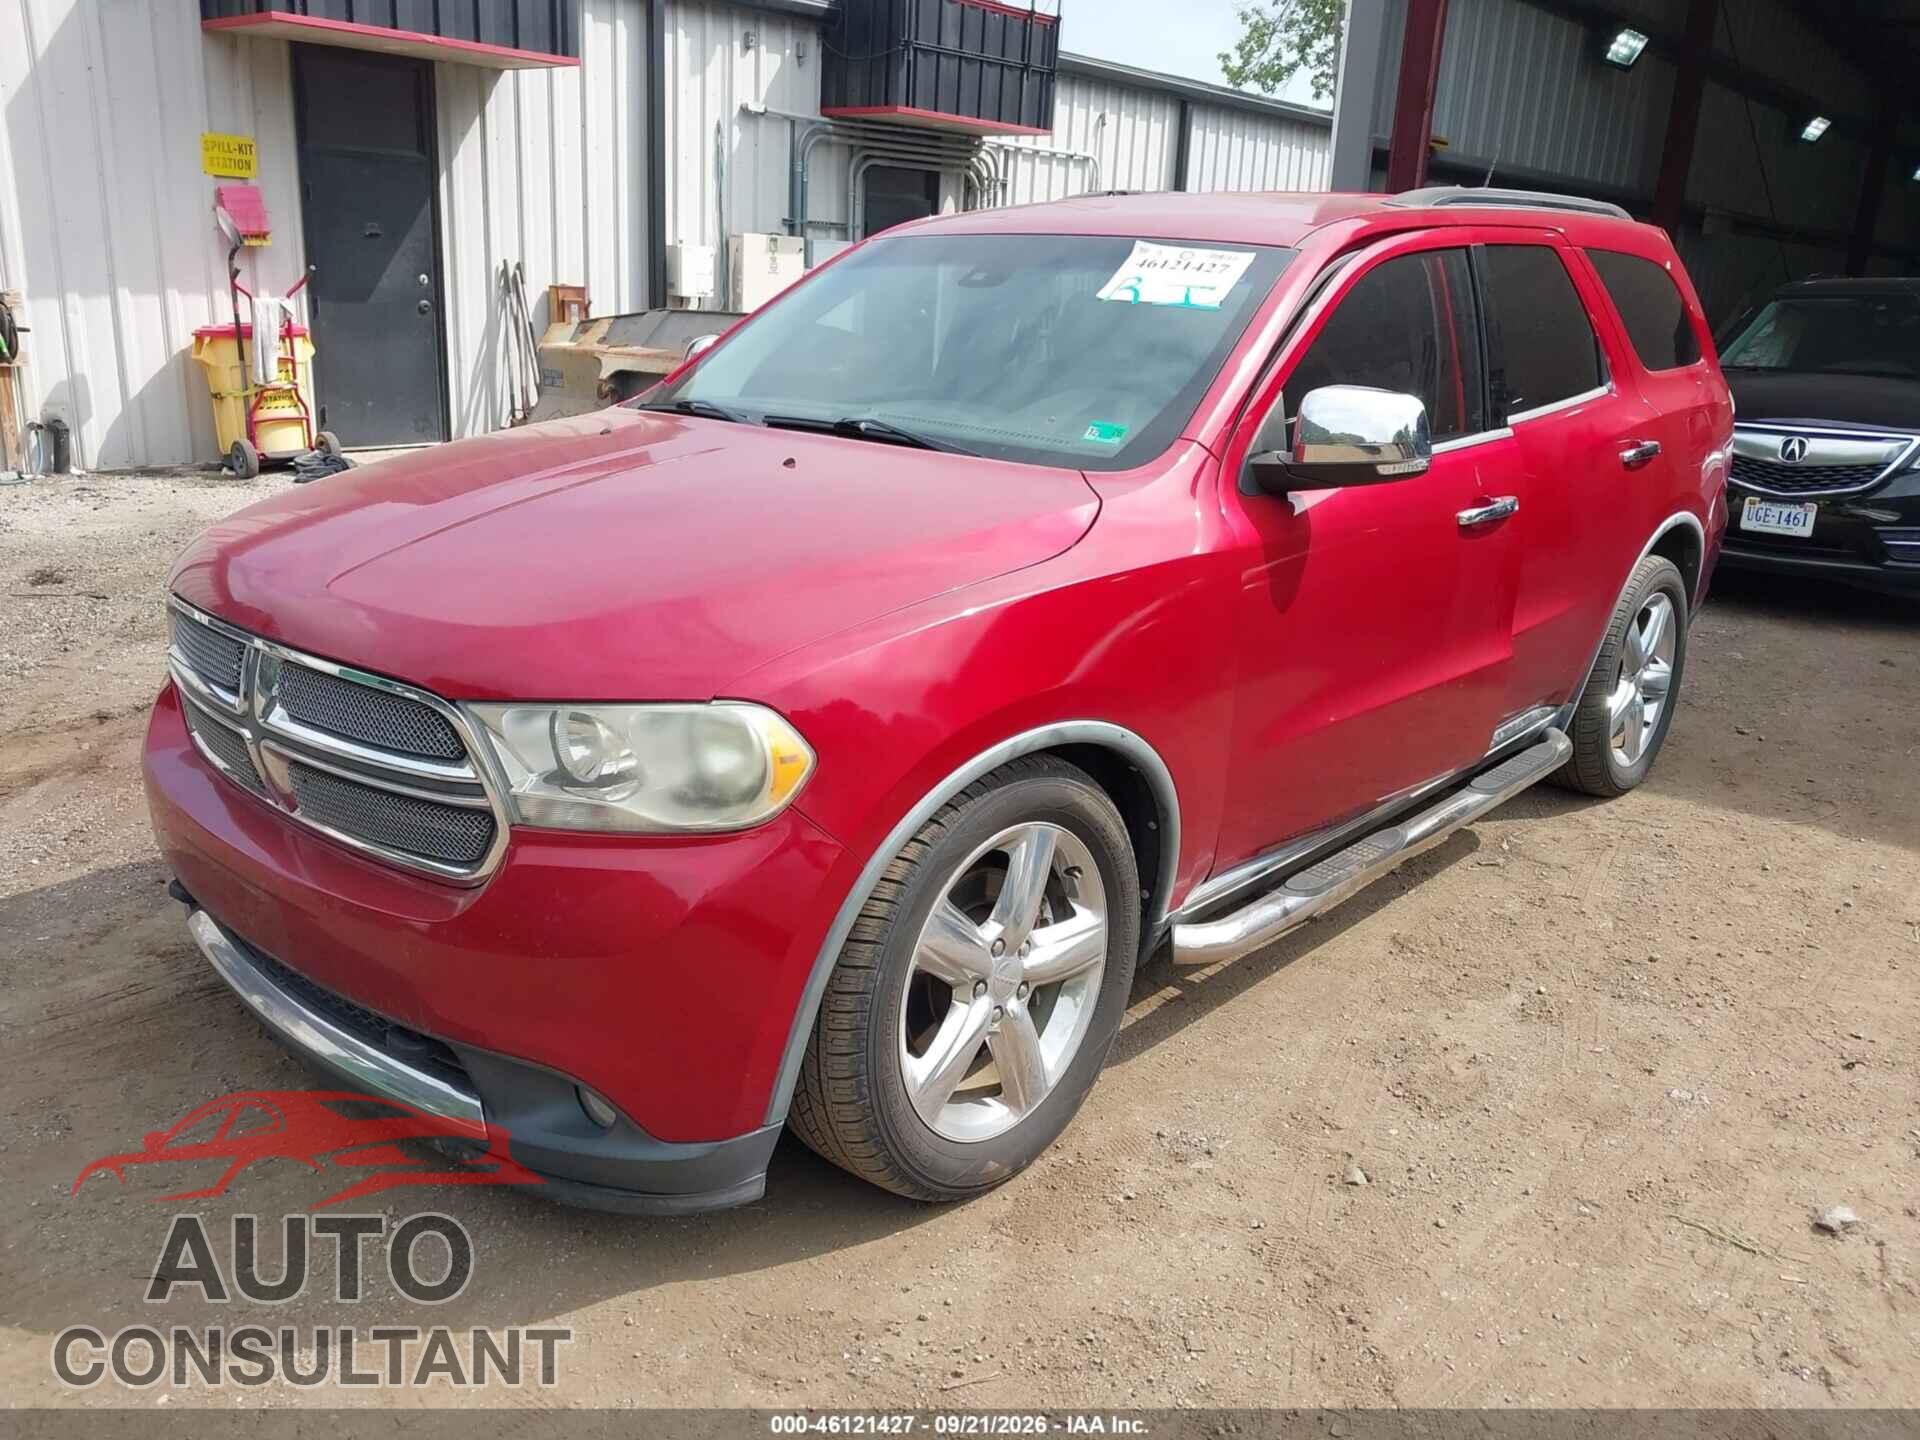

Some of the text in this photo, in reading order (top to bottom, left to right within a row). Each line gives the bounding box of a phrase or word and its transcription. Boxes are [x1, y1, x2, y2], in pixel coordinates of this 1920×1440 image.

[203, 139, 255, 156] SPILL-KIT
[208, 156, 252, 171] STATION
[1135, 258, 1231, 273] 46121427
[1747, 507, 1809, 527] UGE-1461
